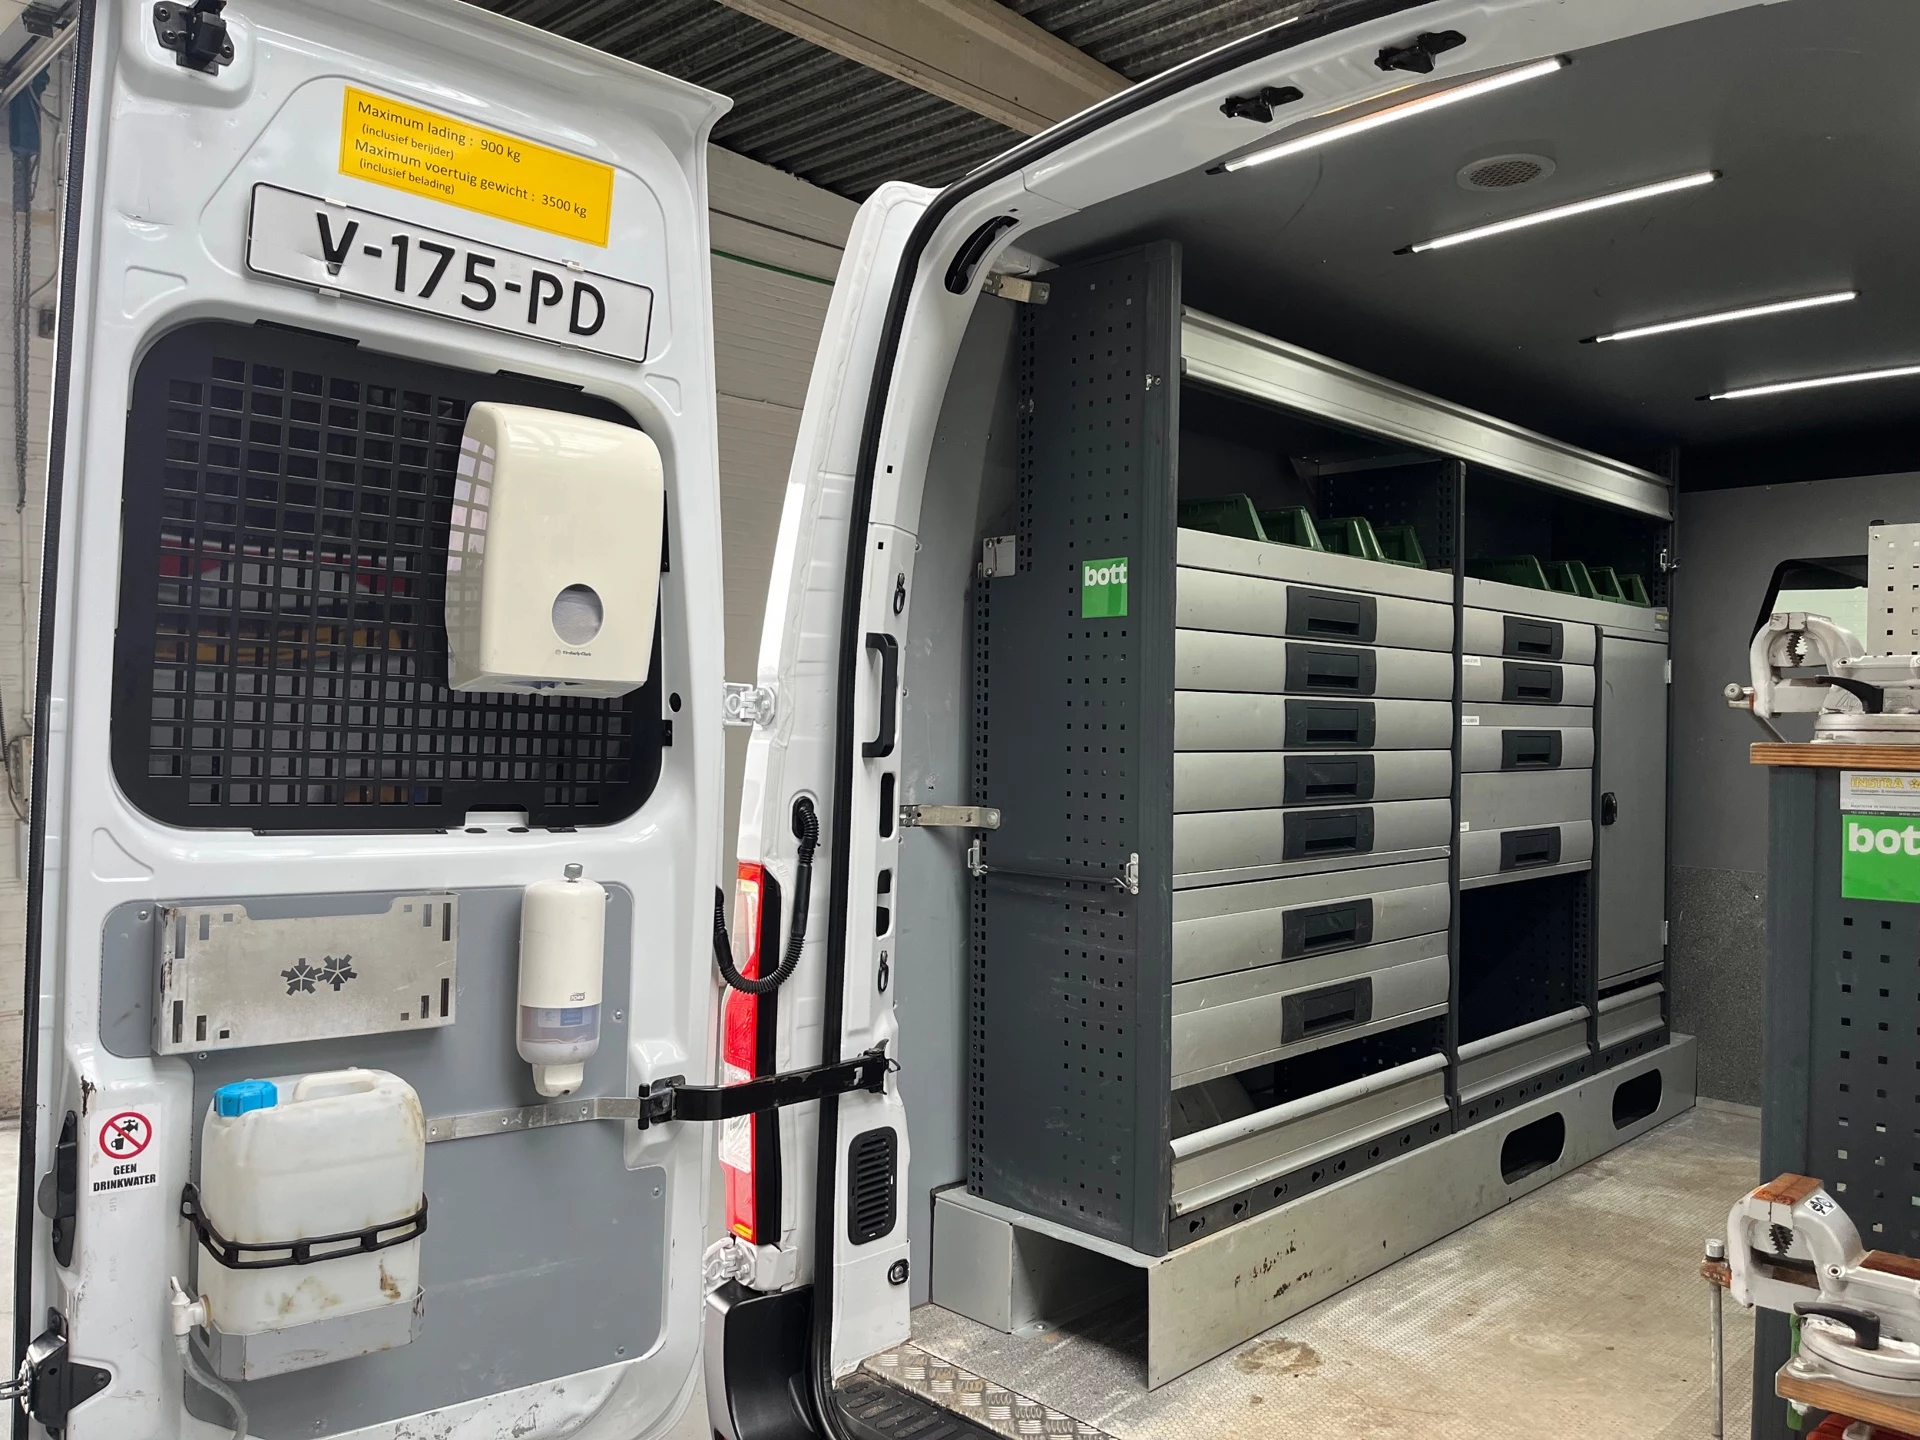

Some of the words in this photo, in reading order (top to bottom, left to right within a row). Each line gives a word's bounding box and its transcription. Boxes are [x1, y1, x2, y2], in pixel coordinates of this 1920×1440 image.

[358, 101, 424, 131] Maximum
[428, 122, 466, 146] lading
[480, 139, 504, 155] 900
[507, 147, 521, 163] kg
[362, 124, 409, 145] (inclusief
[411, 138, 454, 160] berijder)
[355, 139, 421, 168] Maximum
[425, 162, 477, 187] voertuig
[480, 178, 528, 200] gewicht
[541, 194, 571, 212] 3500
[574, 203, 587, 218] kg
[360, 158, 406, 179] (inclusief
[408, 172, 455, 195] belading)
[316, 211, 605, 336] V-175-PD
[1084, 563, 1127, 587] bott
[1850, 777, 1904, 789] INSTRA
[1848, 822, 1920, 856] bot
[93, 1173, 156, 1192] DRINKWATER
[113, 1163, 137, 1175] GEEN
